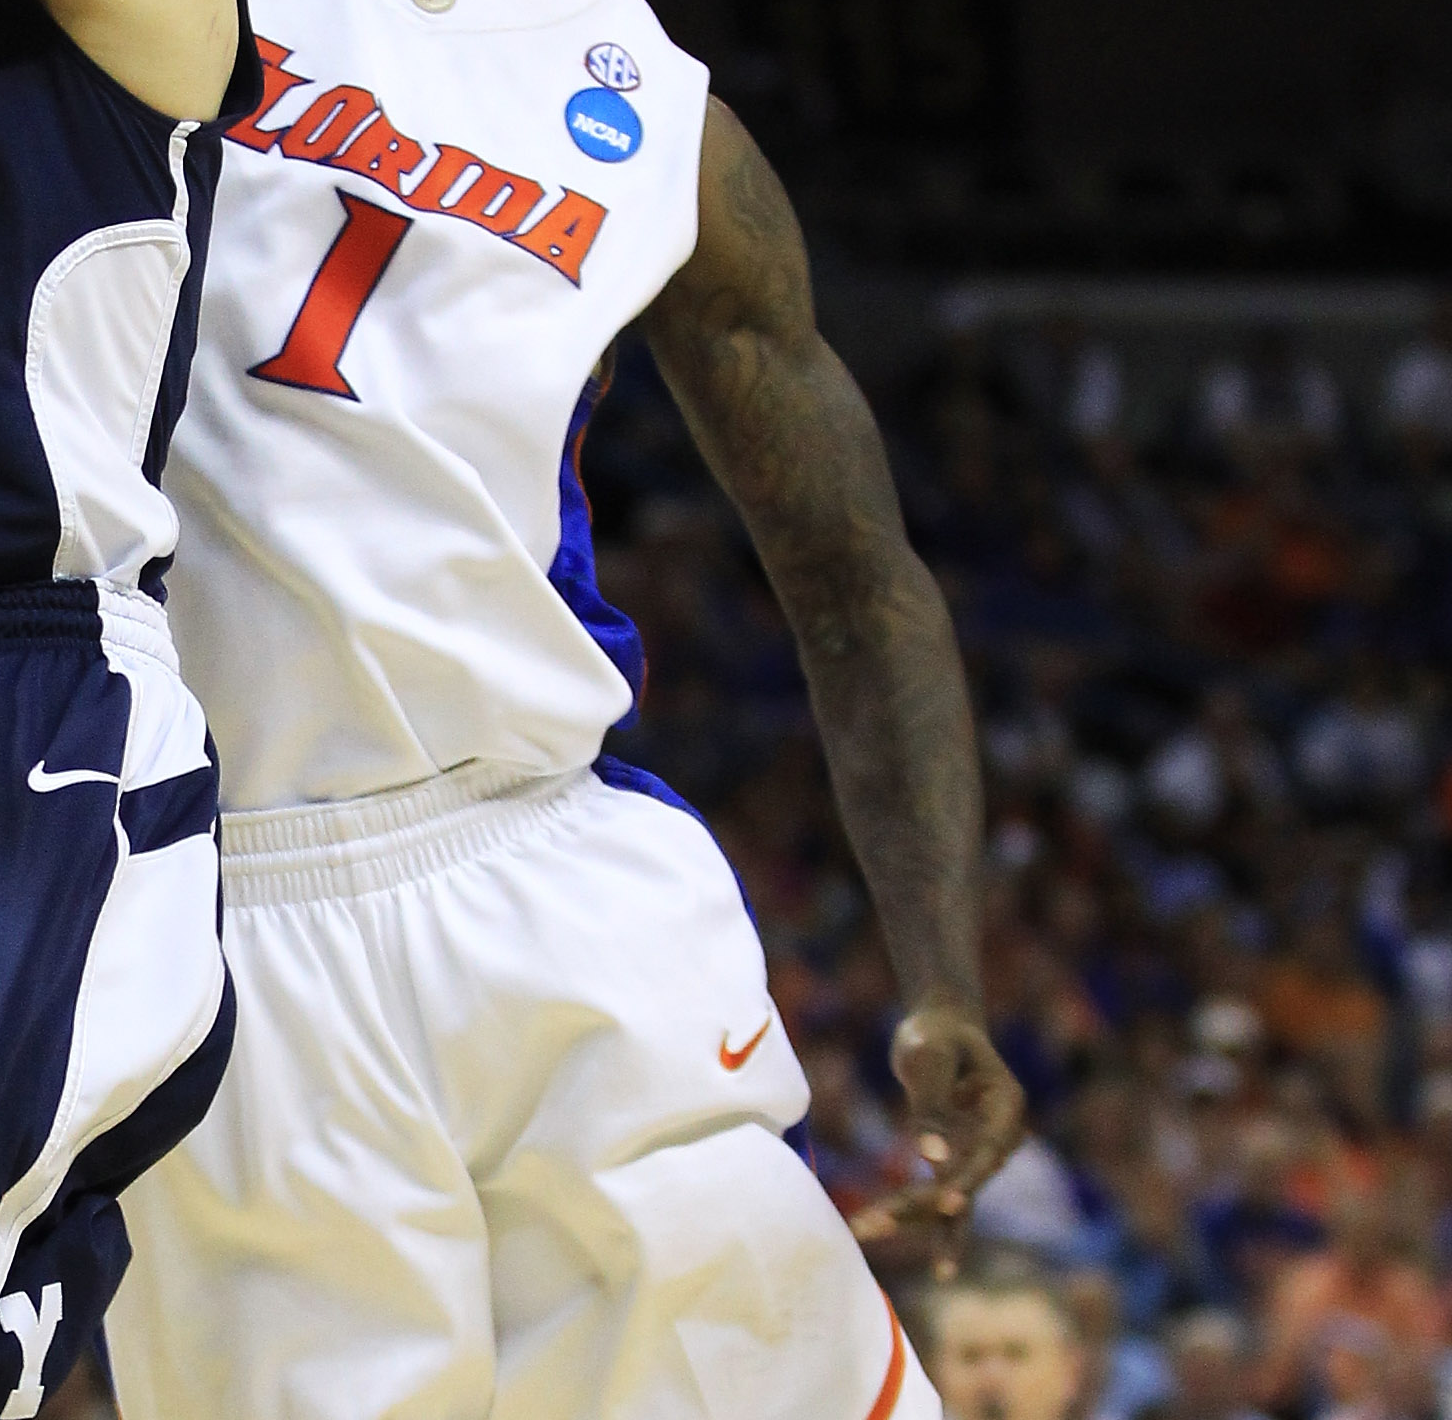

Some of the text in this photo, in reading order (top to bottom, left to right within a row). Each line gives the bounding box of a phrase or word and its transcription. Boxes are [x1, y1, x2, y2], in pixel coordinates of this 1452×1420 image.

[588, 45, 640, 88] SEC
[223, 33, 609, 289] LORIDA
[572, 112, 632, 152] NCAA
[247, 186, 415, 403] 1
